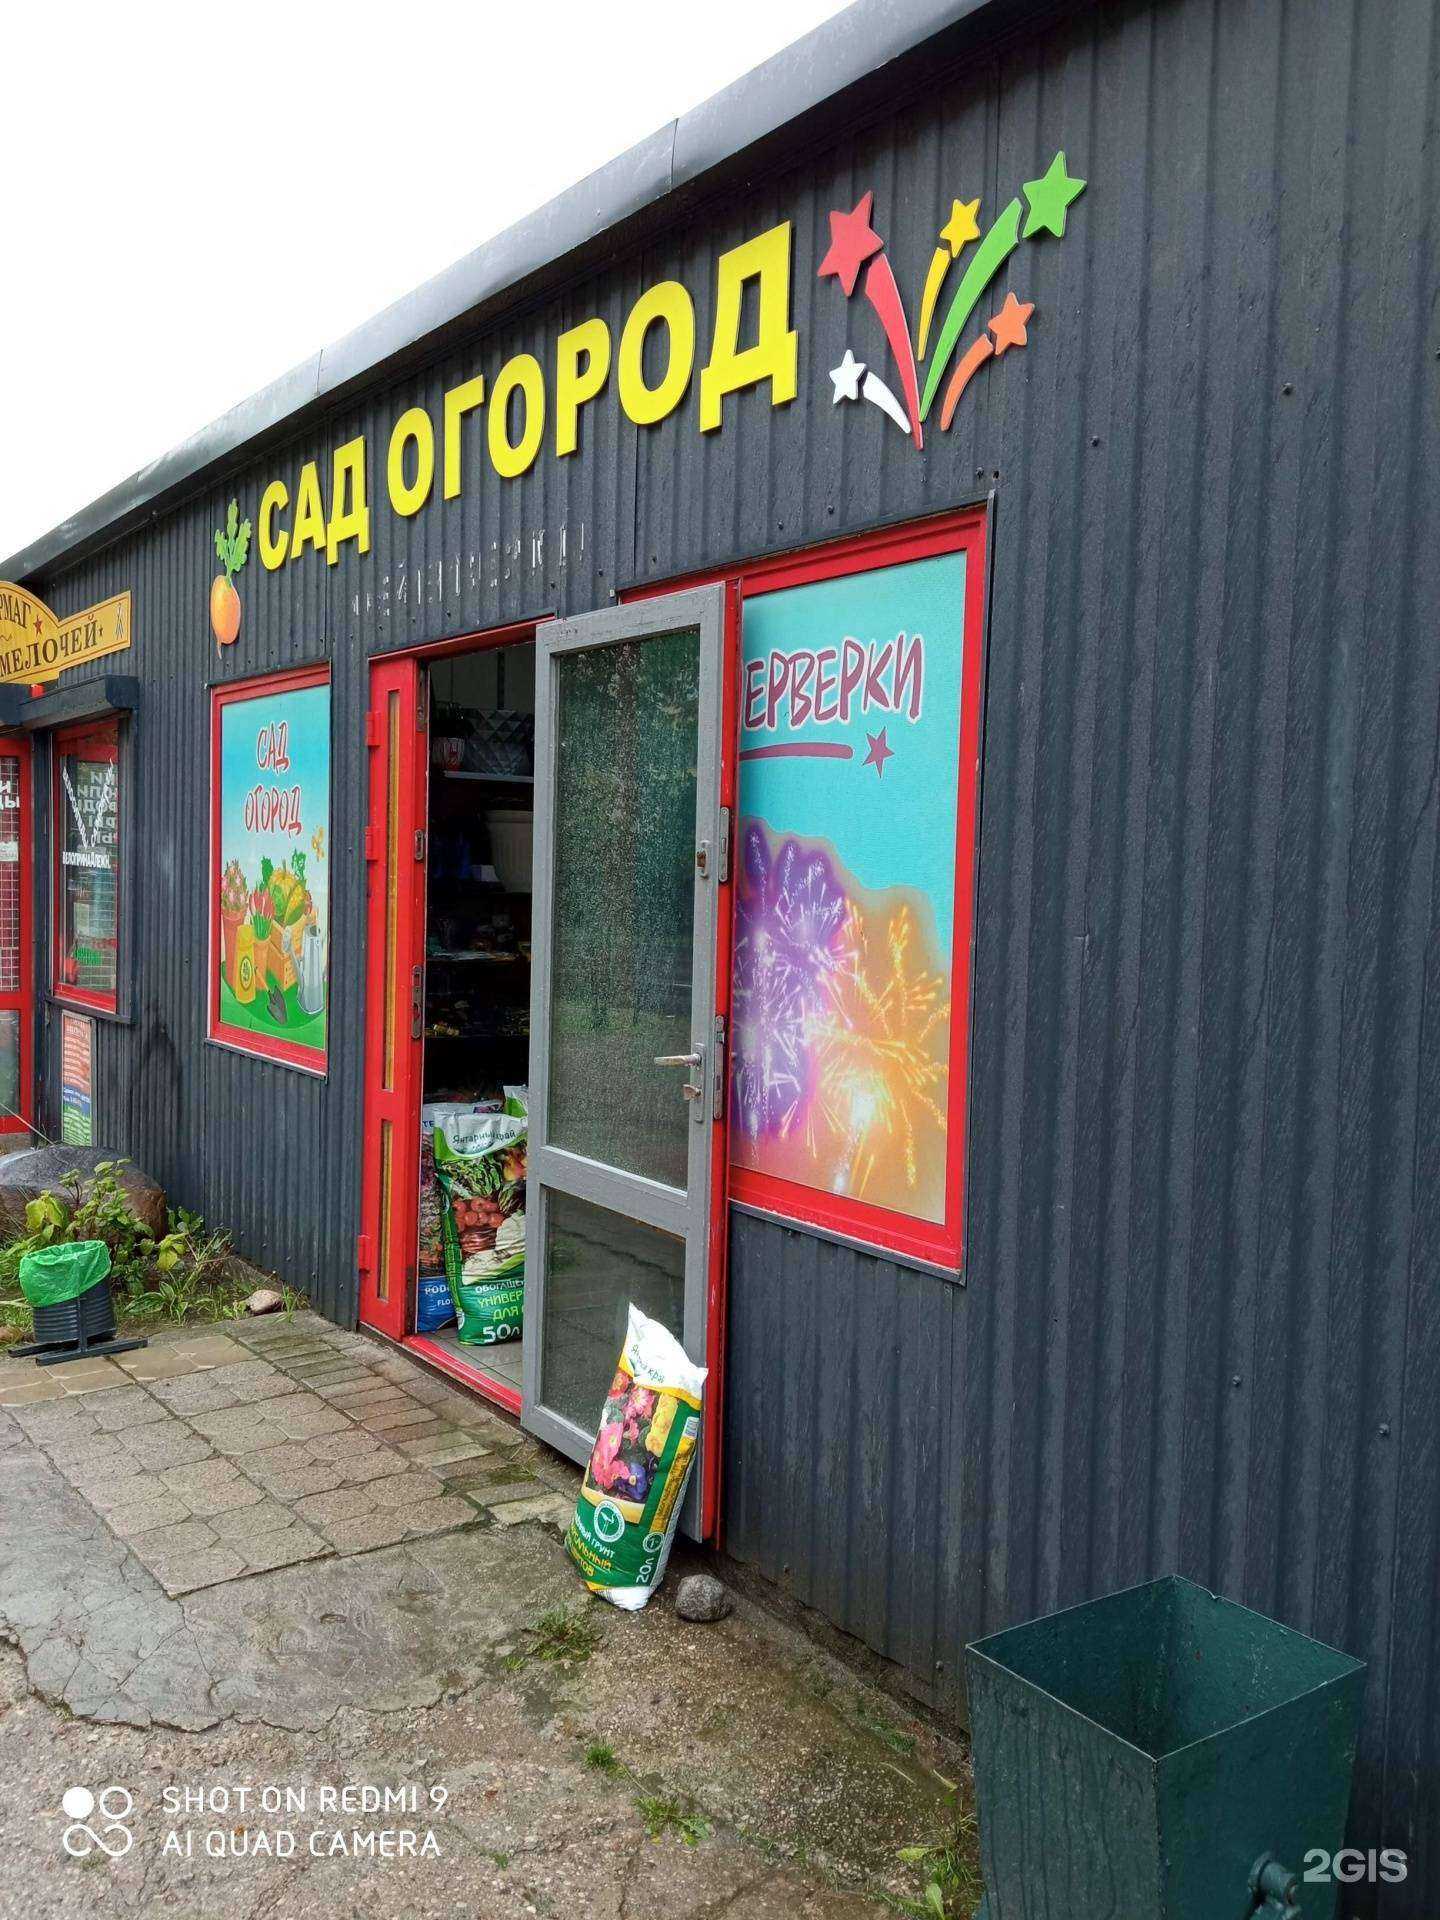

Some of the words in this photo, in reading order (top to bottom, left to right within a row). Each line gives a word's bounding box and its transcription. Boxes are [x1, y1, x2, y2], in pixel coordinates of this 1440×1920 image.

[258, 436, 371, 570] САД
[387, 222, 798, 516] ОГОРОД
[744, 633, 923, 729] ЕРВЕРКИ
[257, 721, 290, 774] САД
[244, 784, 303, 838] ОГОРОД
[474, 1279, 524, 1294] ОБОГАЩЕ
[492, 1306, 519, 1323] ДЛЯ
[590, 1538, 615, 1559] ГРУНТ
